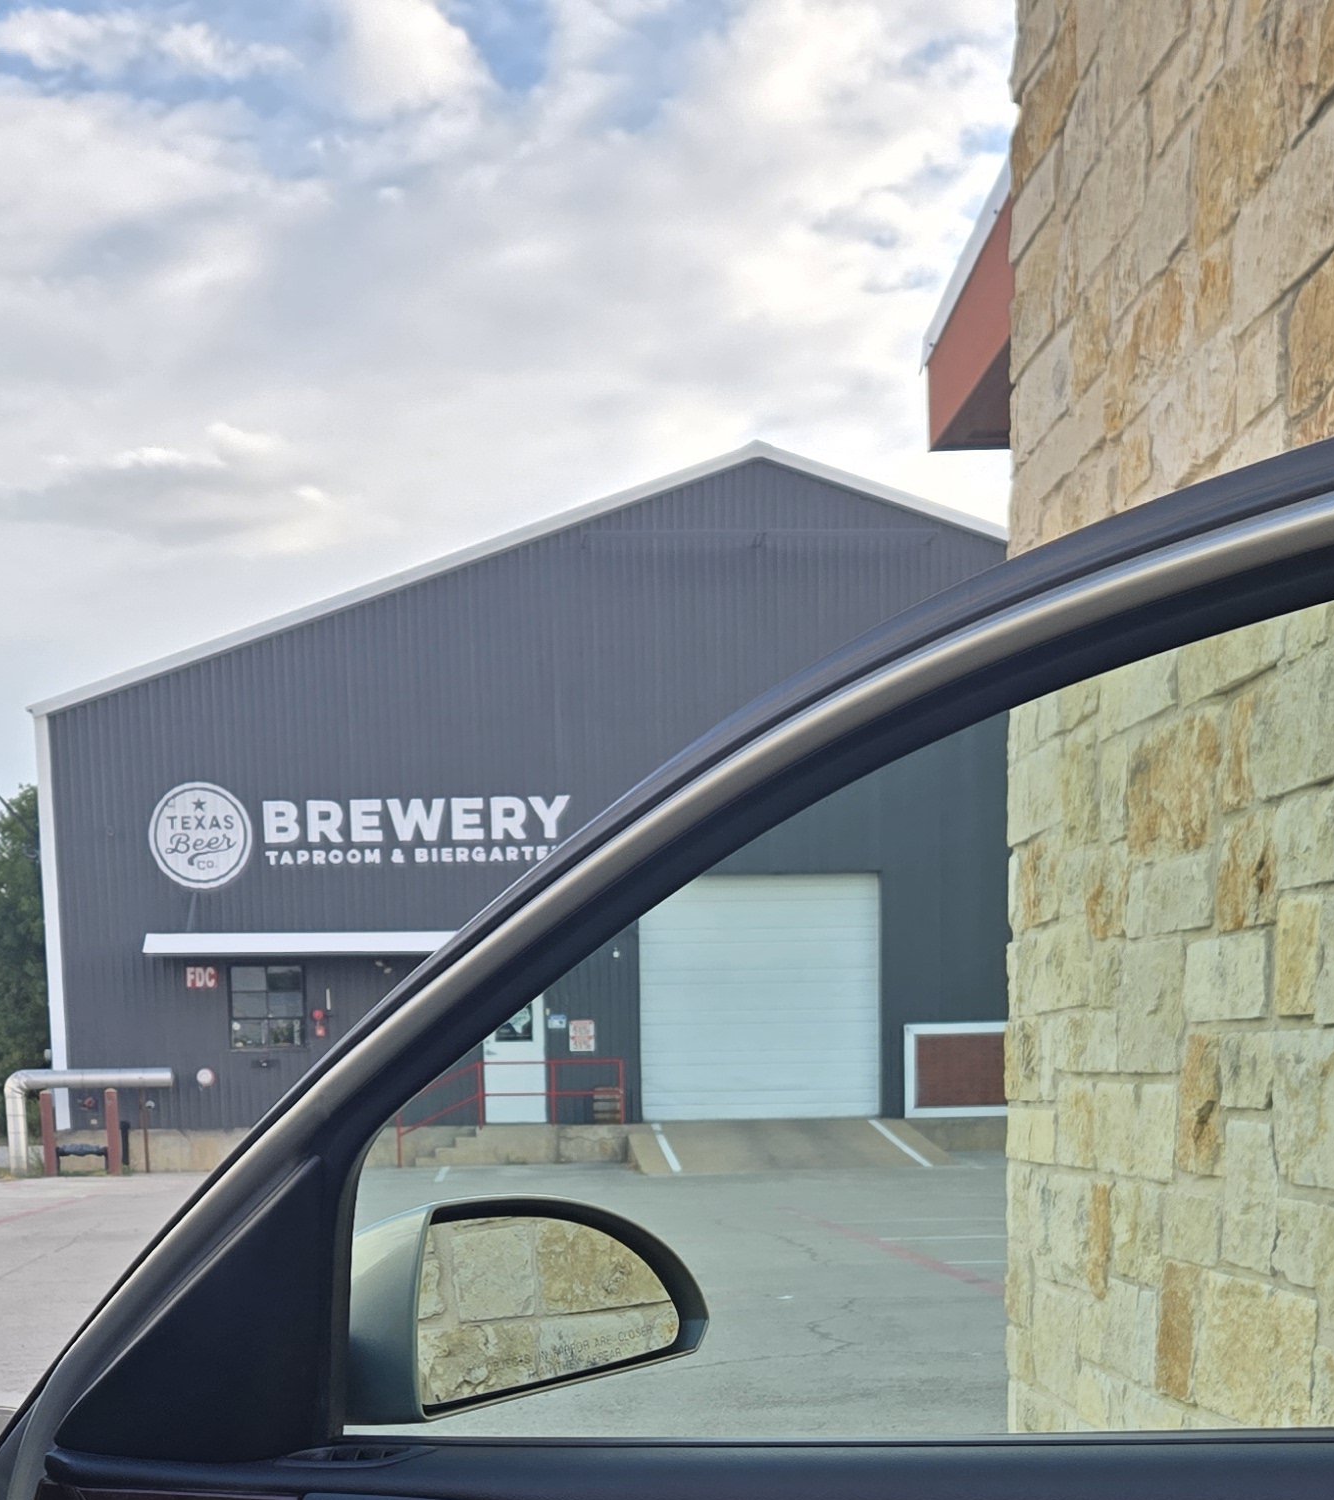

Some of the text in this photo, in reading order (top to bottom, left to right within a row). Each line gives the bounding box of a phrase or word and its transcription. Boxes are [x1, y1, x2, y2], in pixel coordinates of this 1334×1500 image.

[165, 815, 235, 831] TEXAS
[262, 794, 571, 844] BREWERY
[164, 831, 237, 860] Beer
[265, 846, 558, 865] TAPROOM & BIERGARTE
[185, 966, 216, 988] FDC
[594, 1335, 614, 1348] ARE
[618, 1324, 654, 1343] CLOSER
[585, 1347, 623, 1367] APPEAR
